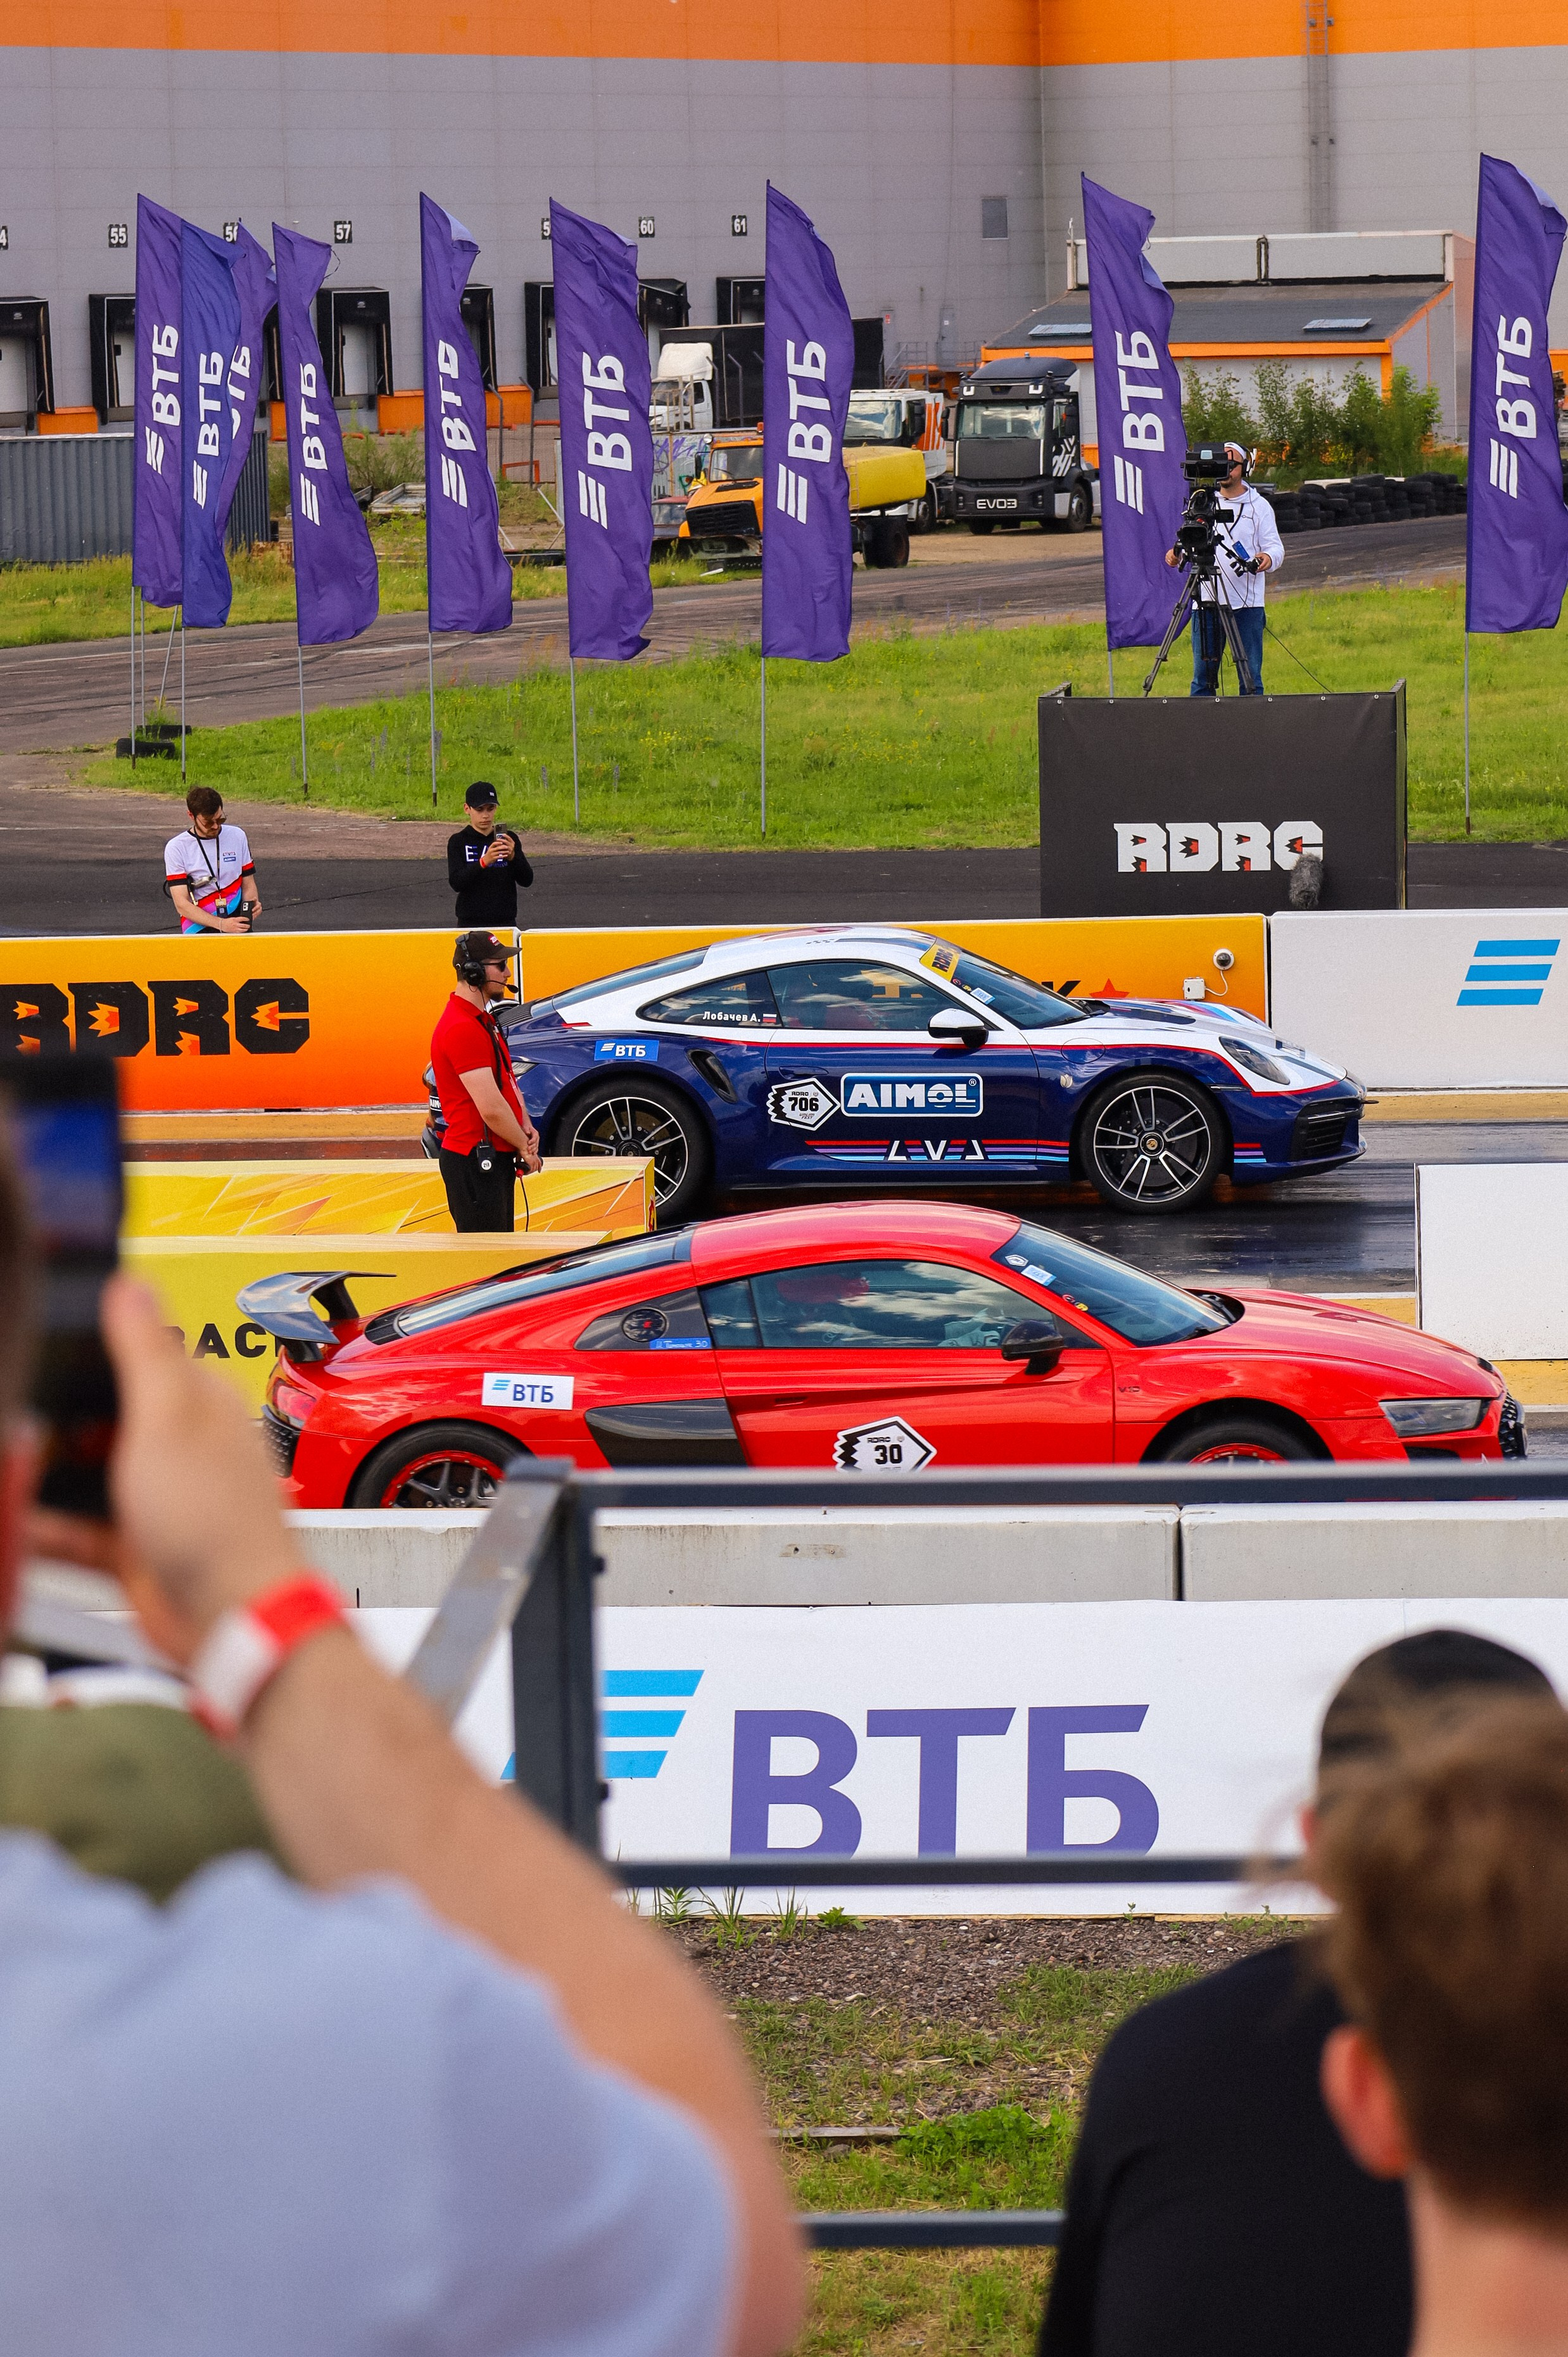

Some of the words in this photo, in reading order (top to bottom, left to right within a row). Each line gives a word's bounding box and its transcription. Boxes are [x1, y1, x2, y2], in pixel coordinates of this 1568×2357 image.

[0, 229, 6, 246] 4
[110, 227, 127, 244] 55
[336, 224, 351, 239] 57
[543, 221, 550, 236] 5
[640, 220, 654, 234] 60
[733, 218, 746, 232] 61
[152, 324, 181, 426] ВТБ
[1115, 330, 1165, 452] ВТБ
[1495, 314, 1537, 438] ВТБ
[197, 352, 224, 457] ВТБ
[438, 340, 476, 451] ВТБ
[582, 352, 633, 472] ВТБ
[786, 339, 832, 463] ВТБ
[300, 363, 327, 471] ВТБ
[1113, 821, 1323, 872] RDRC
[0, 978, 310, 1057] RDRC
[703, 1011, 748, 1022] Лобачев
[615, 1045, 646, 1057] ВТБ
[788, 1097, 819, 1112] 706
[513, 1384, 554, 1403] ВТБ
[875, 1444, 902, 1464] 30
[730, 1704, 1160, 1860] ВТБ
